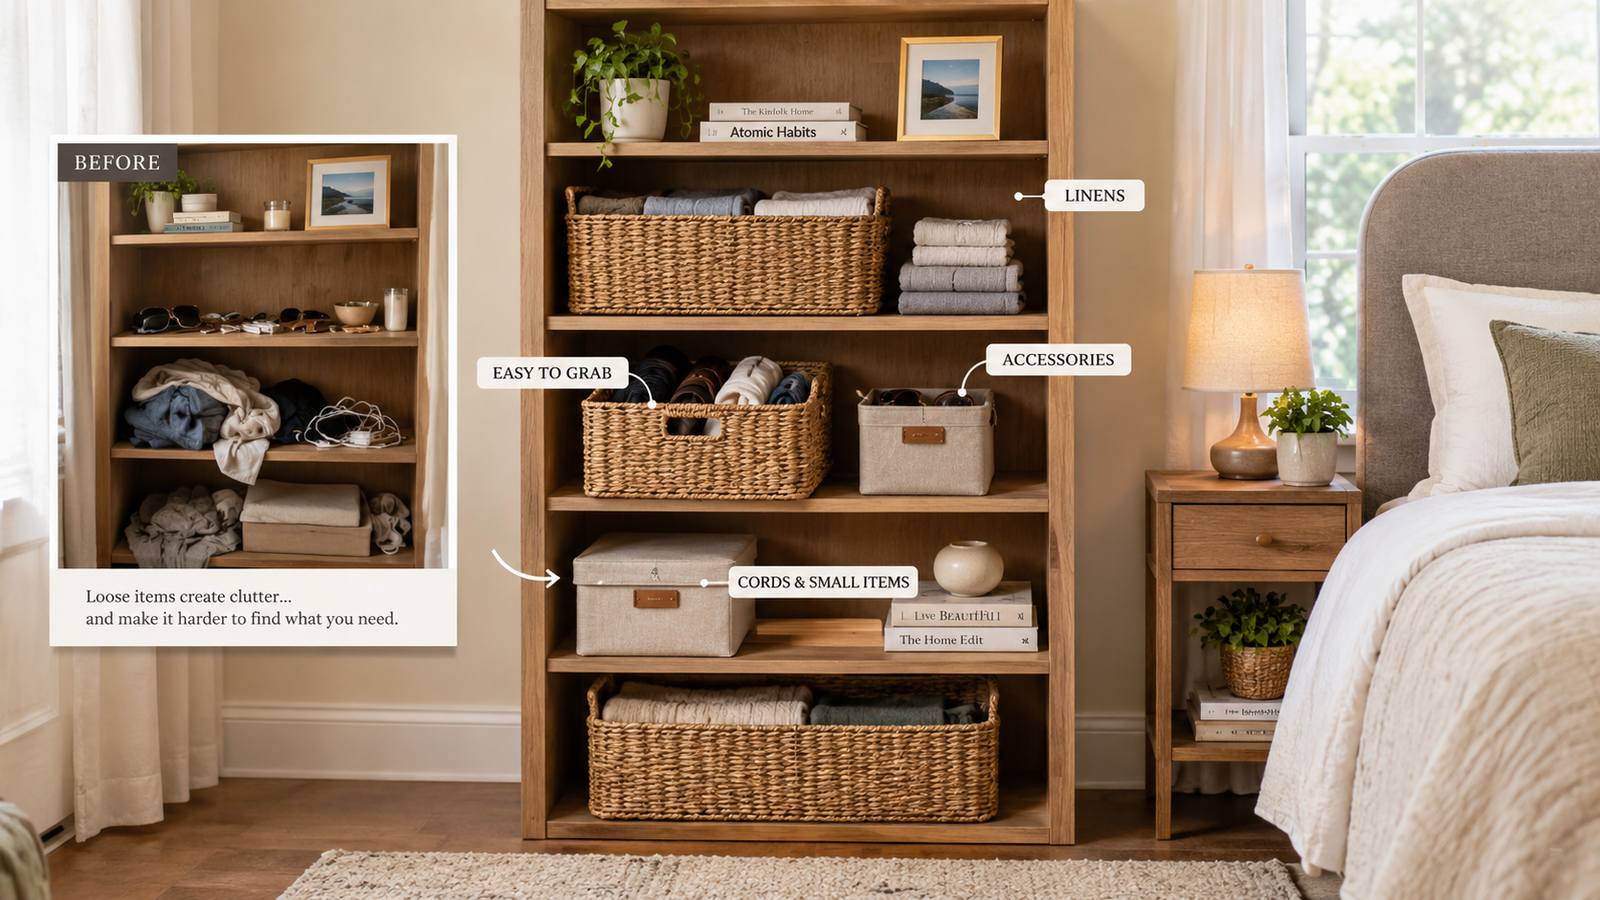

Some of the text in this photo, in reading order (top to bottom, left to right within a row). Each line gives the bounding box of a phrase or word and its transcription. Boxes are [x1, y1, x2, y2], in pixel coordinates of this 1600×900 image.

[741, 107, 757, 115] The
[790, 107, 814, 116] Home
[730, 126, 773, 138] Atomic
[777, 126, 816, 138] Habits
[899, 634, 984, 645] The Home Edit
